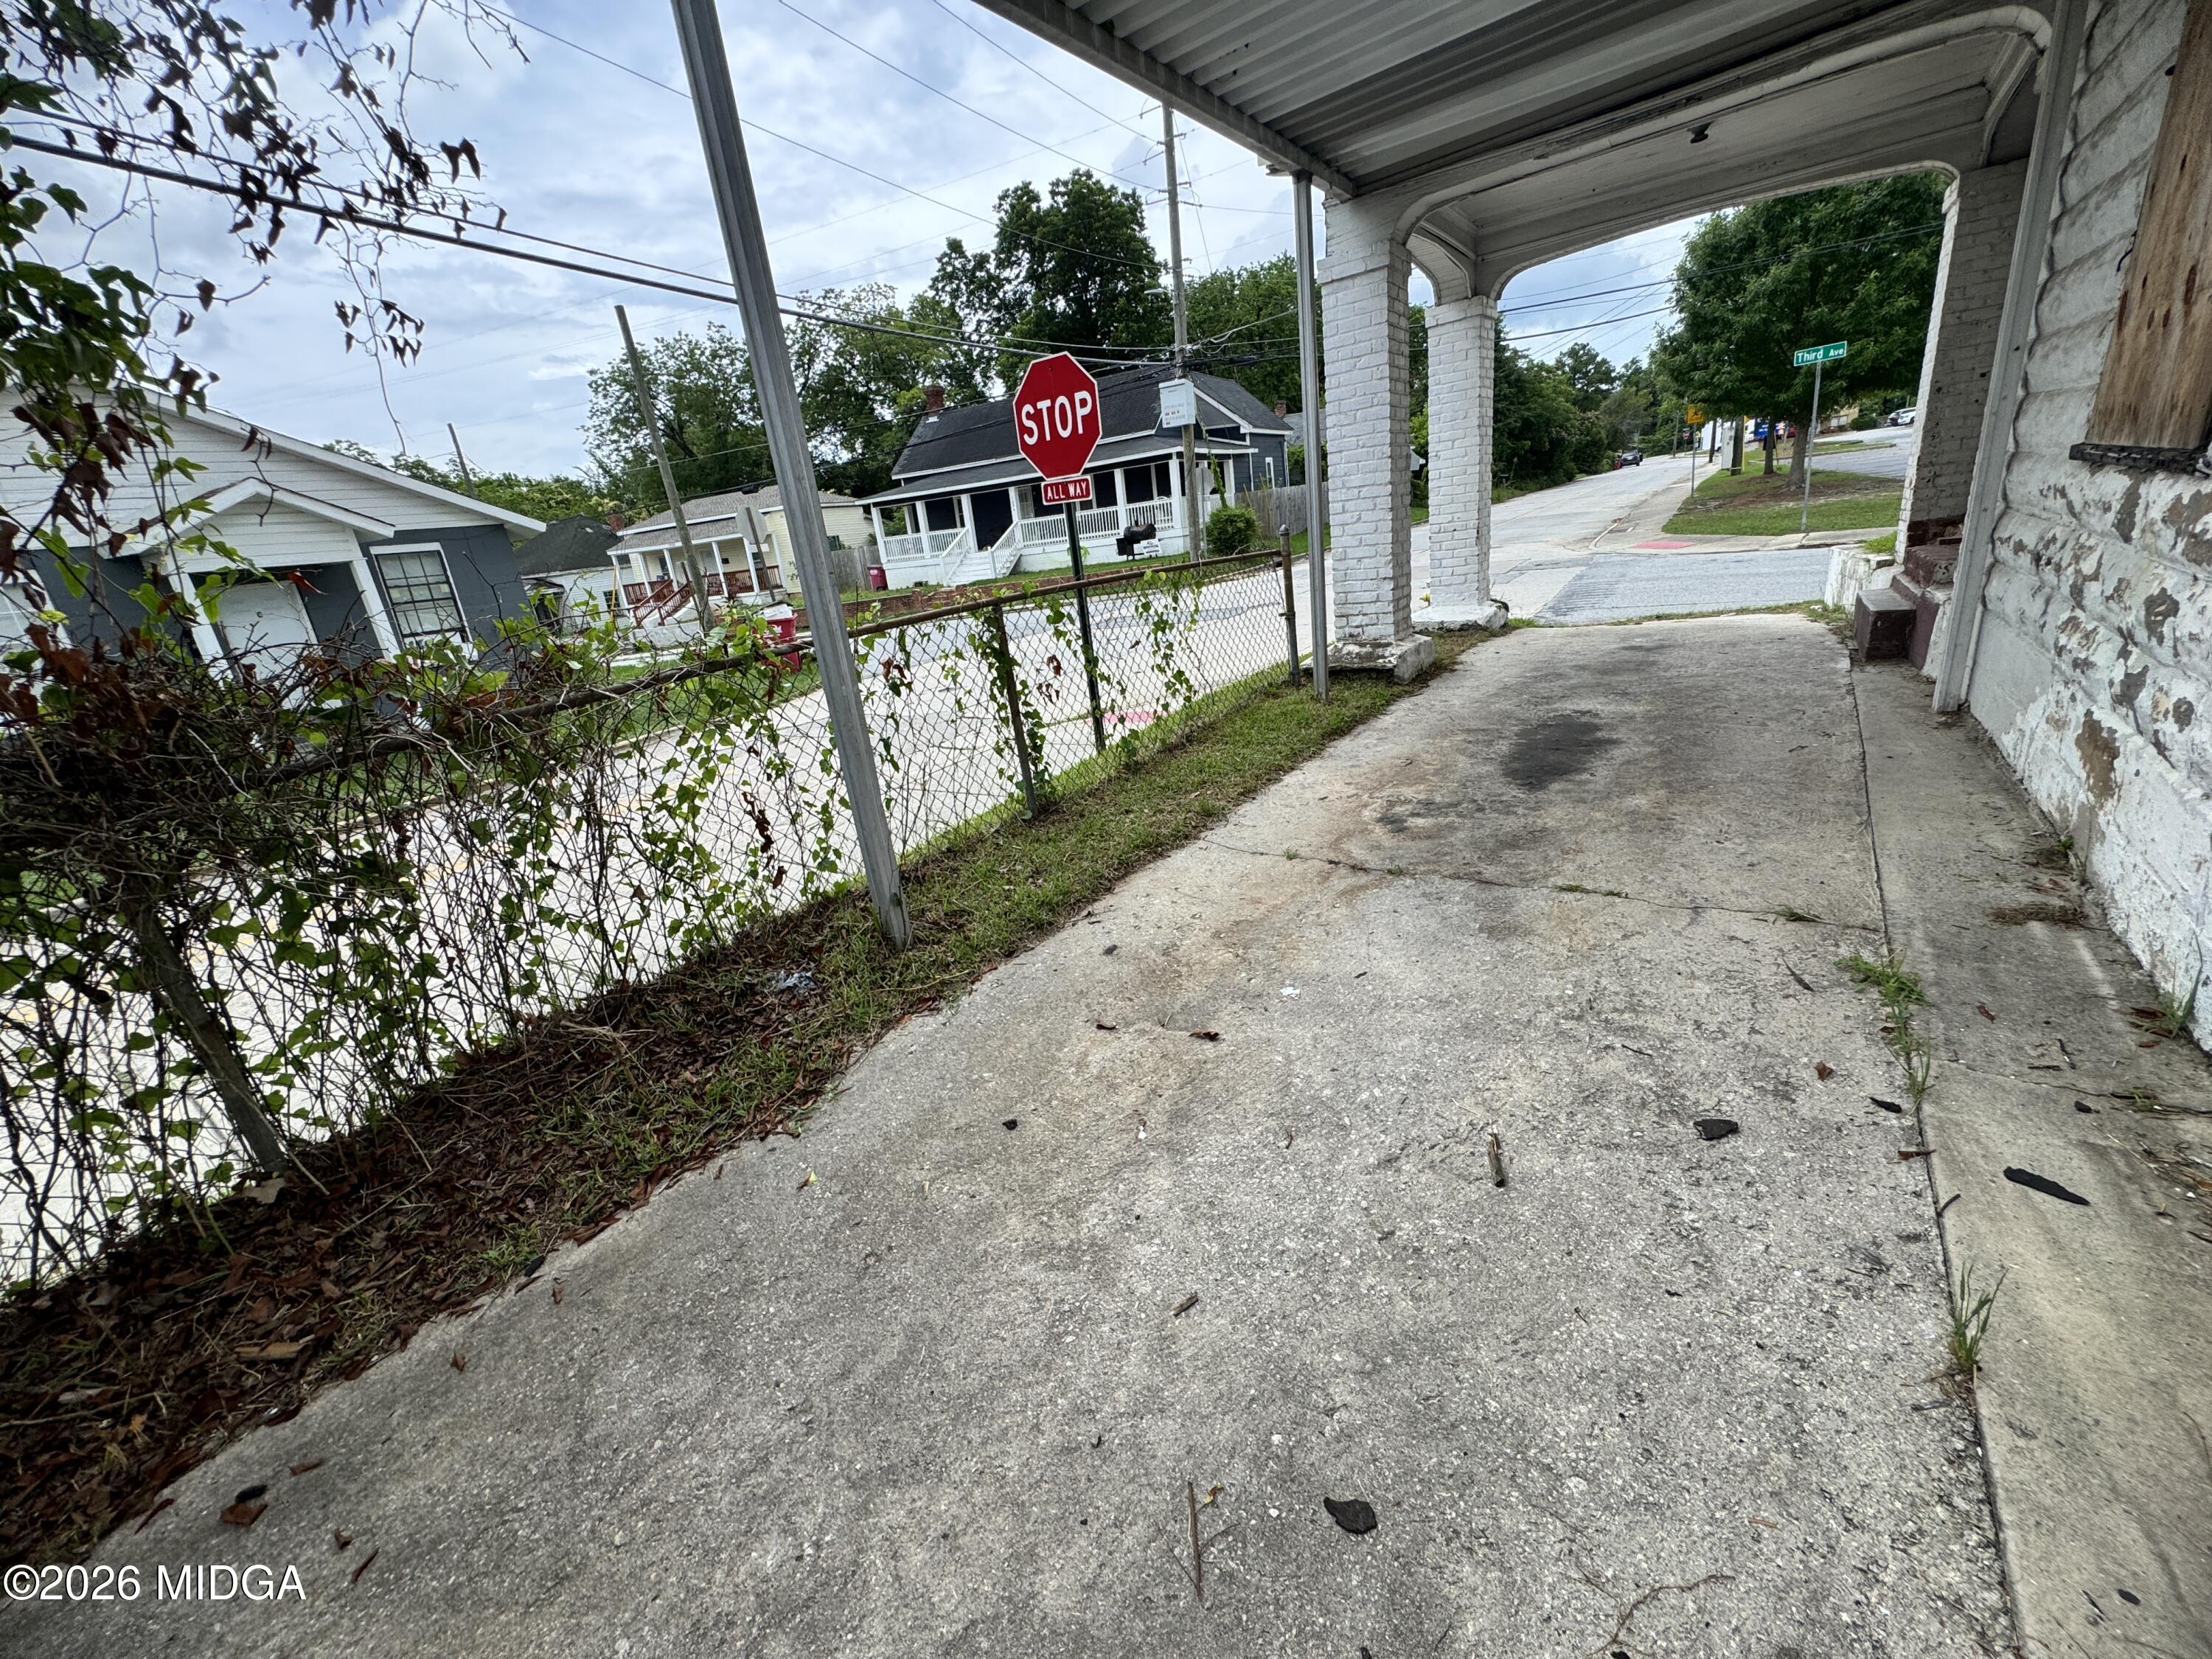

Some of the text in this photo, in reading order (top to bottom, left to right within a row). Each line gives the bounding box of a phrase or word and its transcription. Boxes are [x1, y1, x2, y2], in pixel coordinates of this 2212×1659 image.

[1798, 348, 1844, 363] Third Ave
[1021, 390, 1092, 445] STOP
[1047, 481, 1086, 500] ALL WAY
